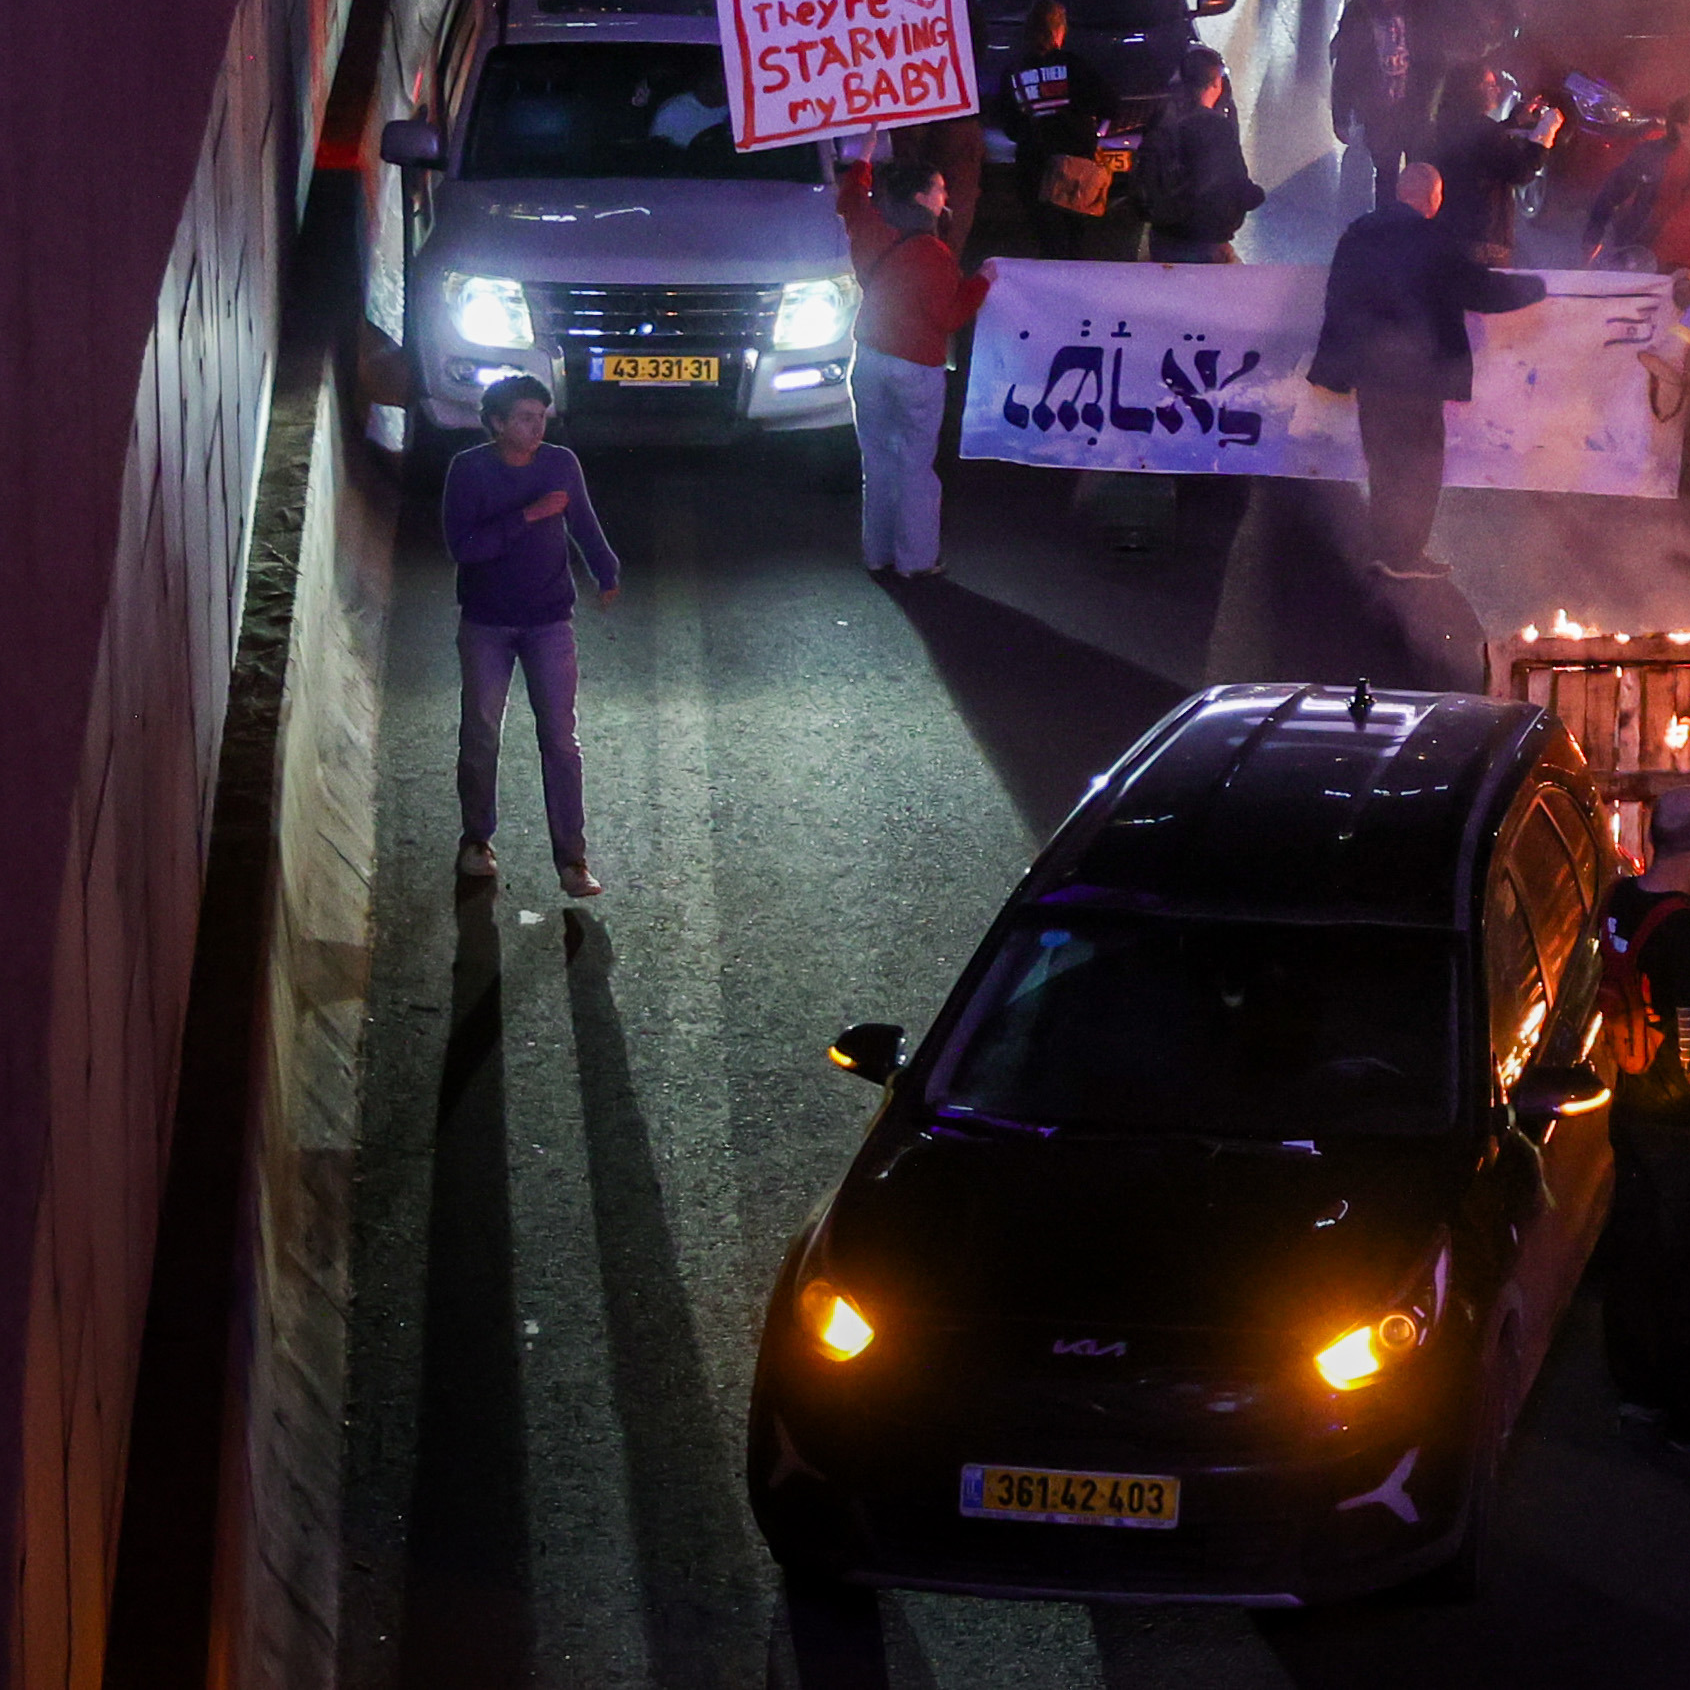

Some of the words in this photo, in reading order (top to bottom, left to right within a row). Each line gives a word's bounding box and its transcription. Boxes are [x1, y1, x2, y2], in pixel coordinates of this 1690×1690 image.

[758, 15, 949, 94] STARVING
[788, 95, 837, 128] my
[842, 56, 949, 115] BABY
